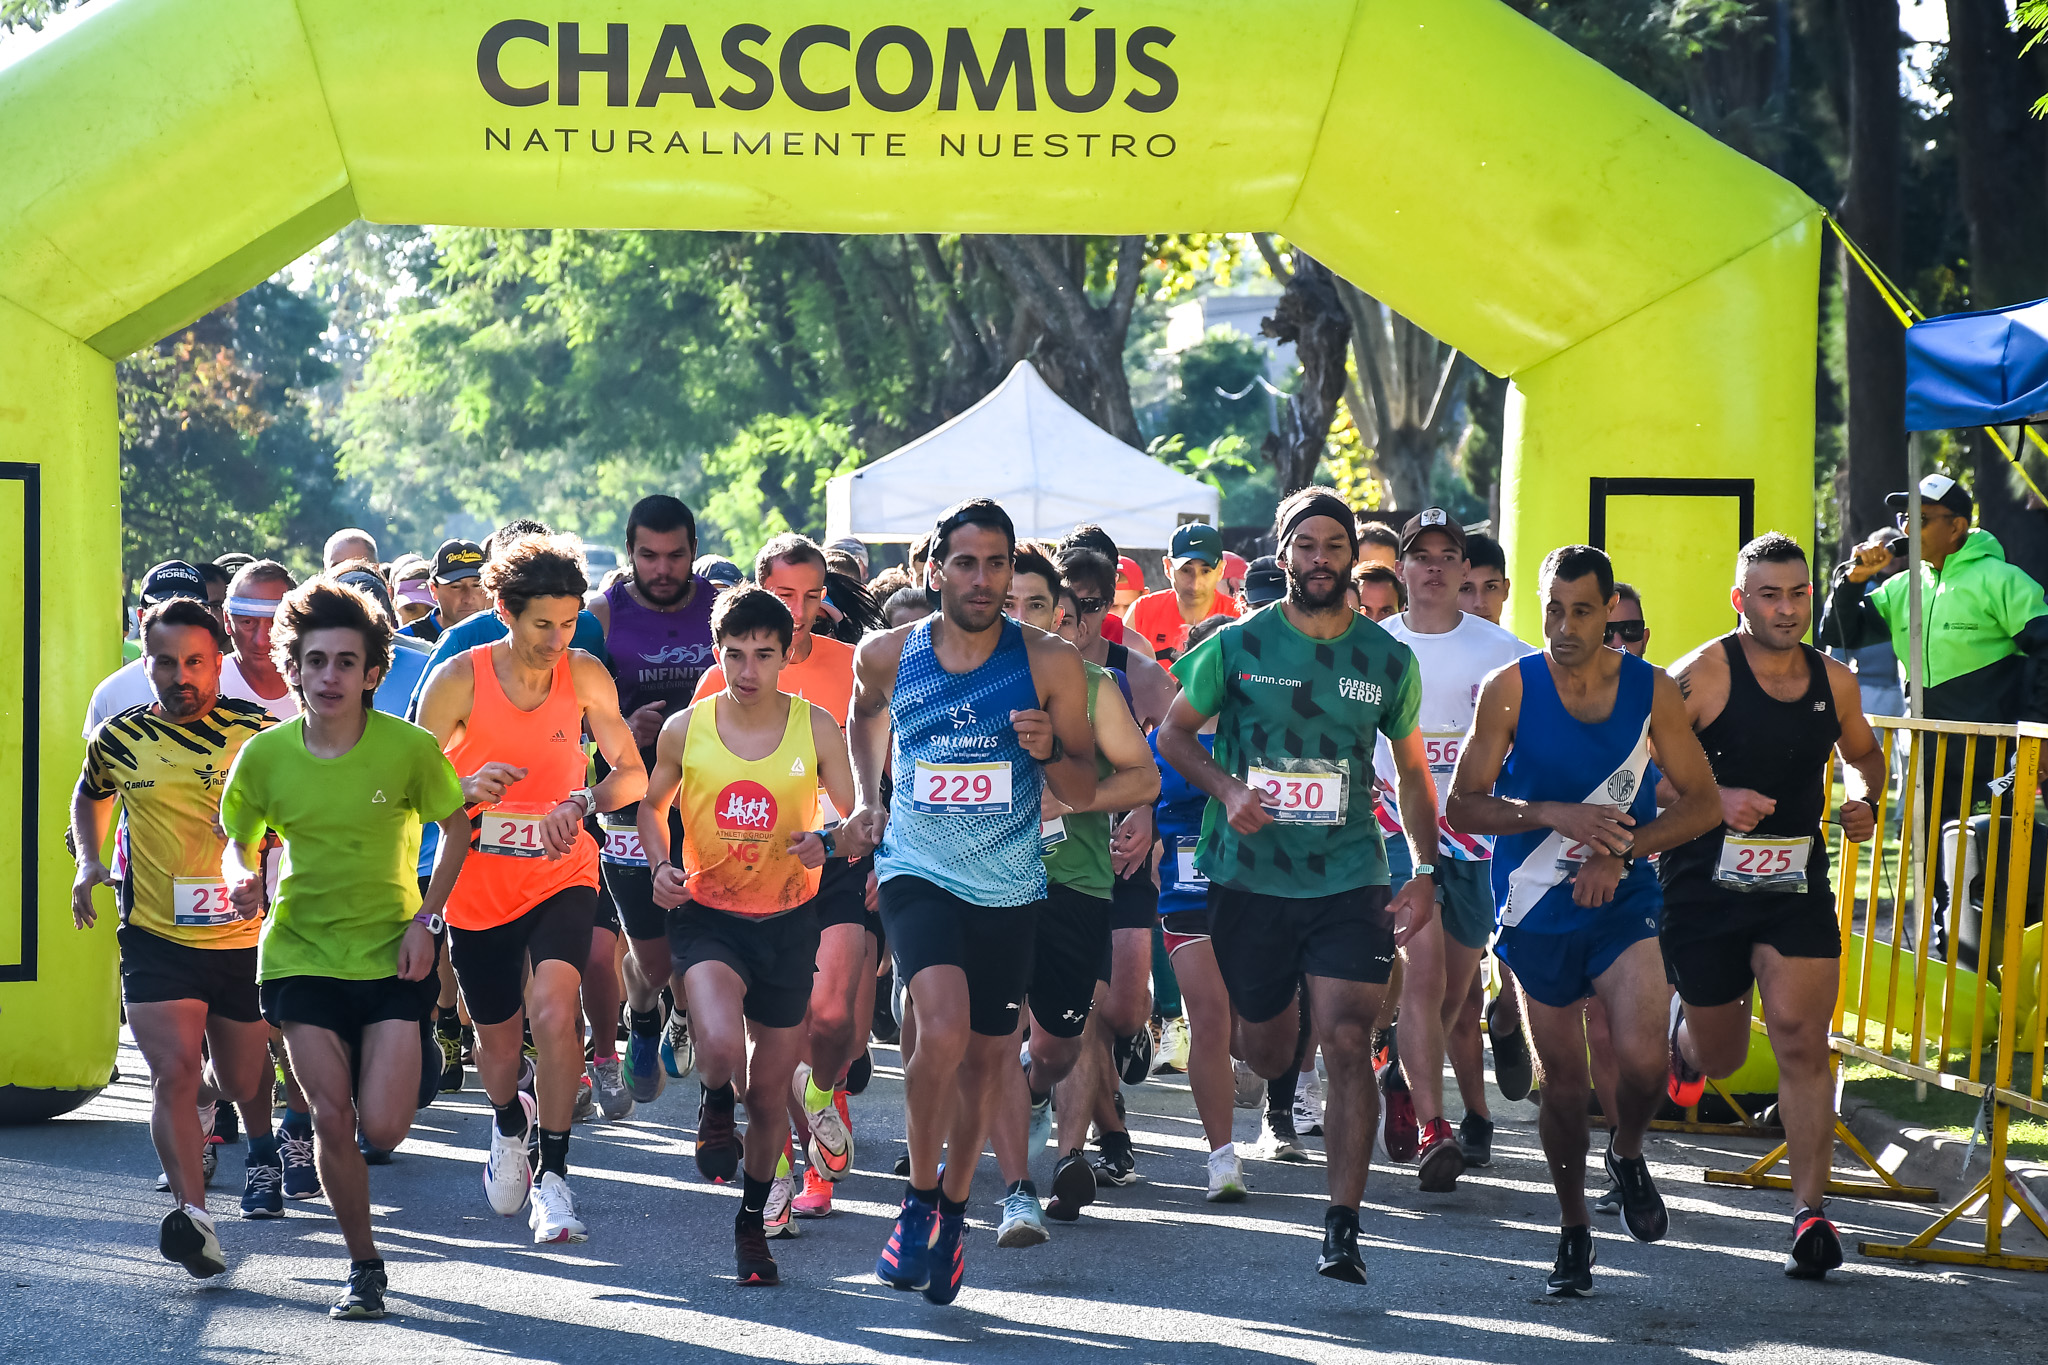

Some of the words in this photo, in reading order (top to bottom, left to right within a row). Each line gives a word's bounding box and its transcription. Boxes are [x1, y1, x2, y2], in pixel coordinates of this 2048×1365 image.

[476, 7, 1180, 113] CHASCOMÚS
[485, 127, 907, 157] NATURALMENTE
[940, 132, 1178, 158] NUESTRO
[156, 571, 199, 583] MORENO
[1338, 676, 1383, 694] CARRERA
[1338, 684, 1383, 706] VERDE
[930, 734, 950, 748] SIN
[952, 735, 999, 749] LIMITES
[1426, 740, 1459, 764] 56
[928, 774, 992, 802] 229
[1265, 779, 1324, 809] 230
[498, 821, 543, 848] 21
[603, 833, 645, 858] 252
[715, 830, 748, 839] ATHLETIC
[727, 842, 760, 864] NG
[1736, 848, 1793, 873] 225
[192, 886, 233, 914] 23
